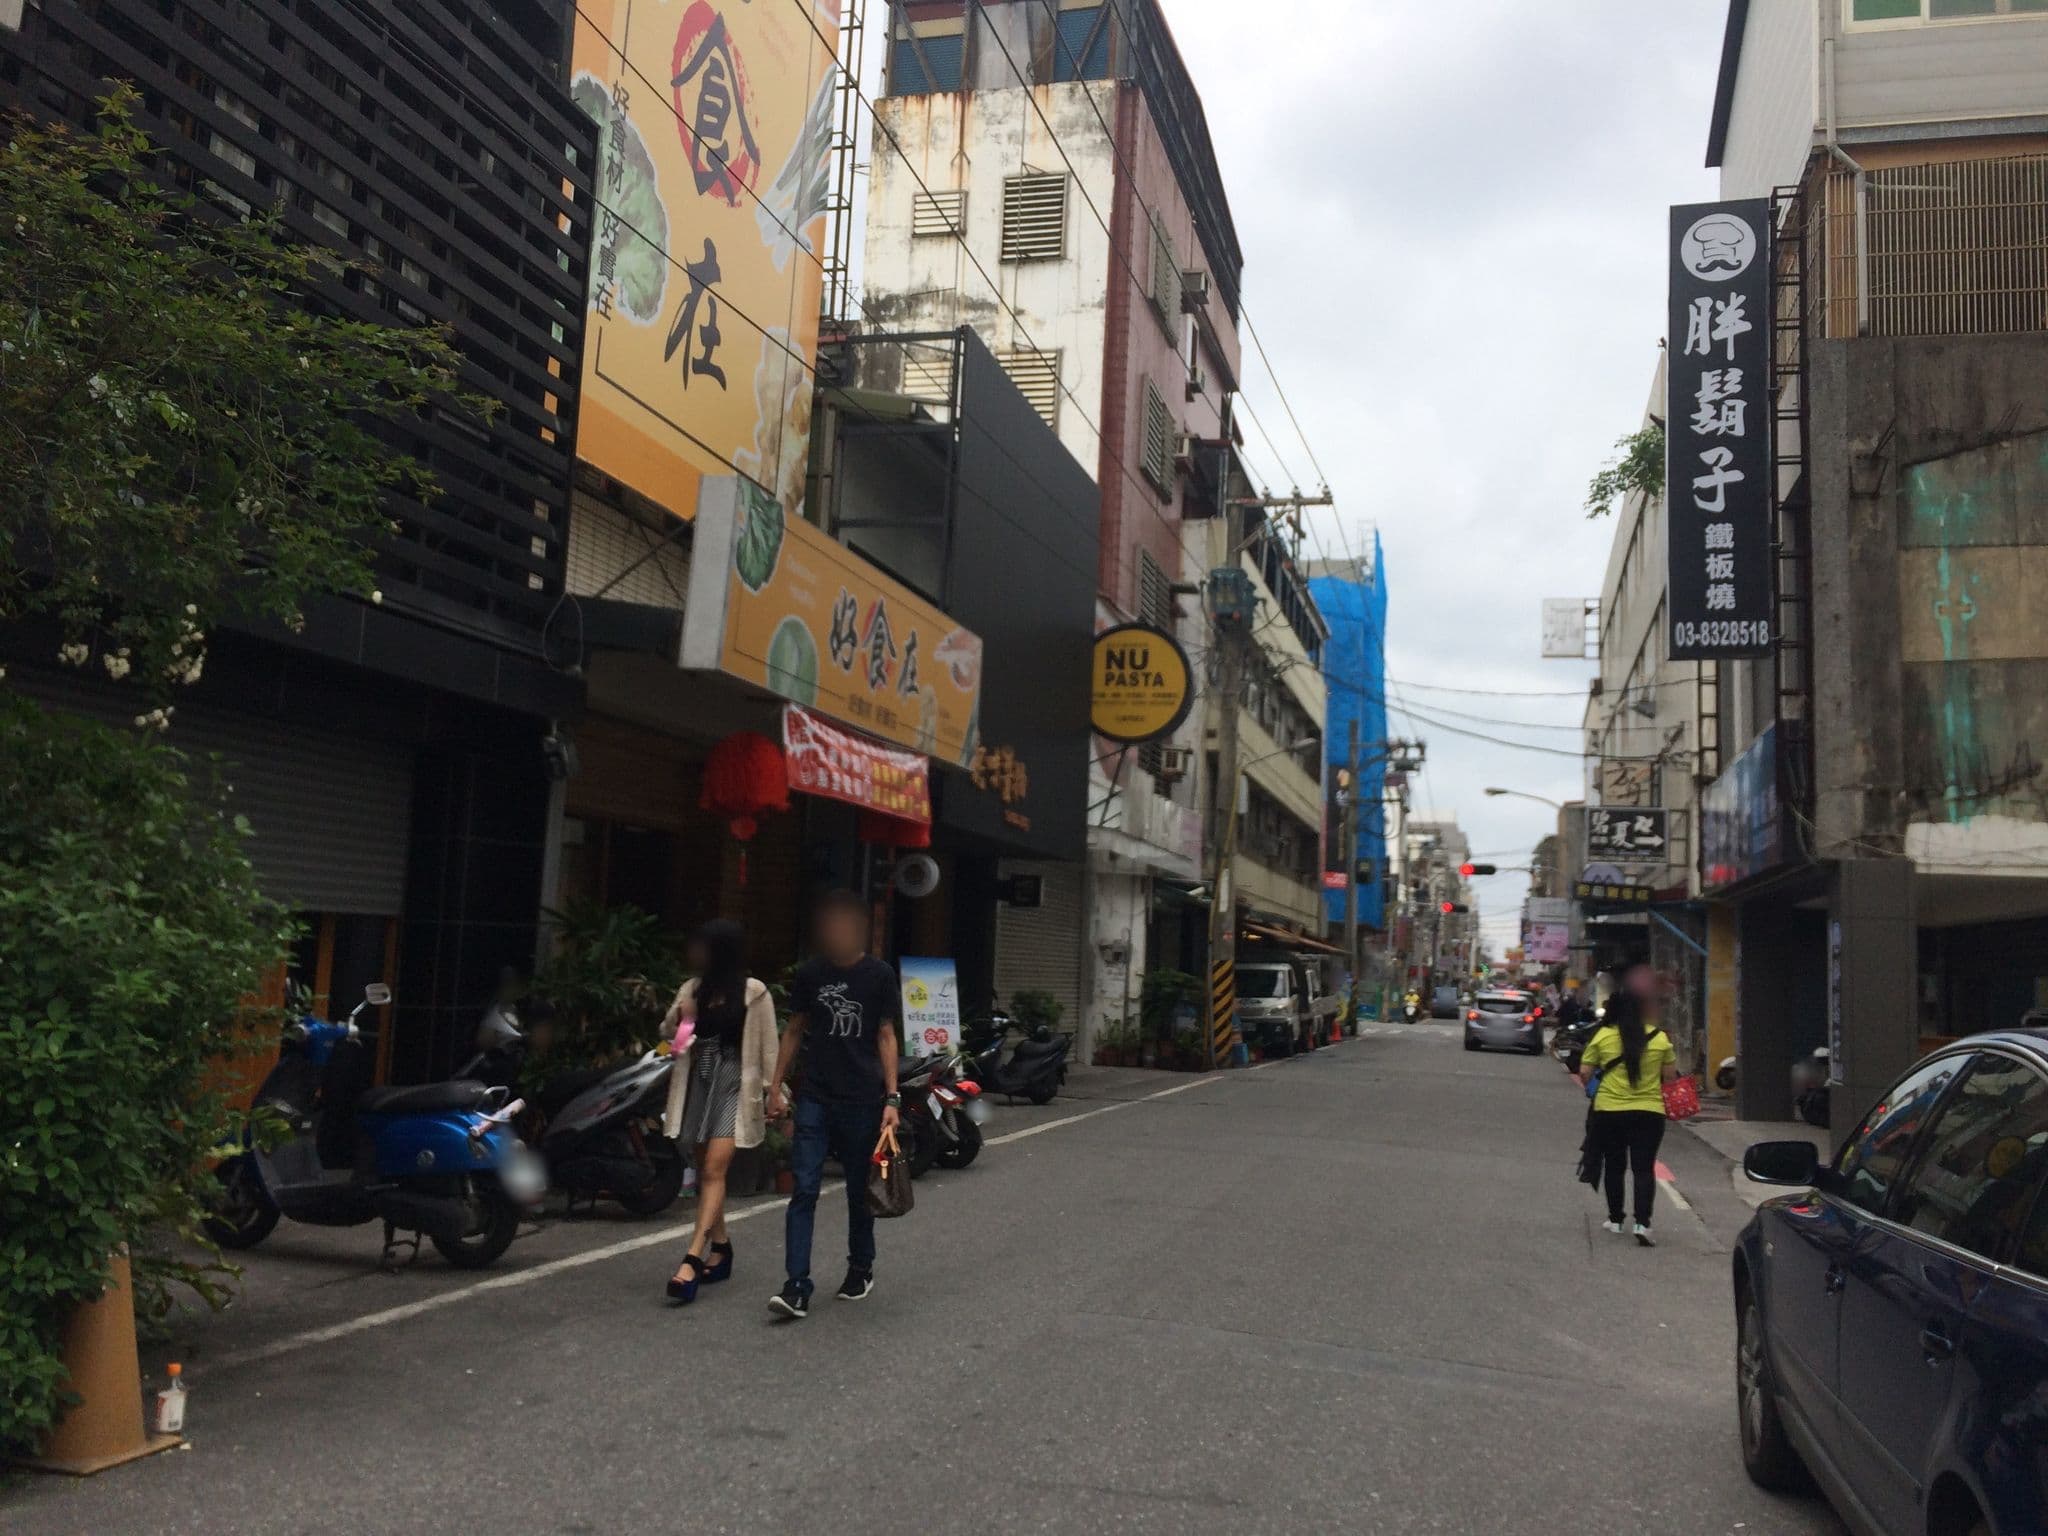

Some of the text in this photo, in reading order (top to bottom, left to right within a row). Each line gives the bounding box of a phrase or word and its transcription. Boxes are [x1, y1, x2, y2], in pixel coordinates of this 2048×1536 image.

[606, 79, 630, 194] 好食材
[1684, 291, 1753, 513] 胖鬍子
[1704, 522, 1736, 611] 鐵板燒
[829, 585, 920, 696] 好食在
[1105, 648, 1149, 671] NU
[1674, 621, 1770, 647] 03-8328518
[1104, 671, 1165, 687] PASTA
